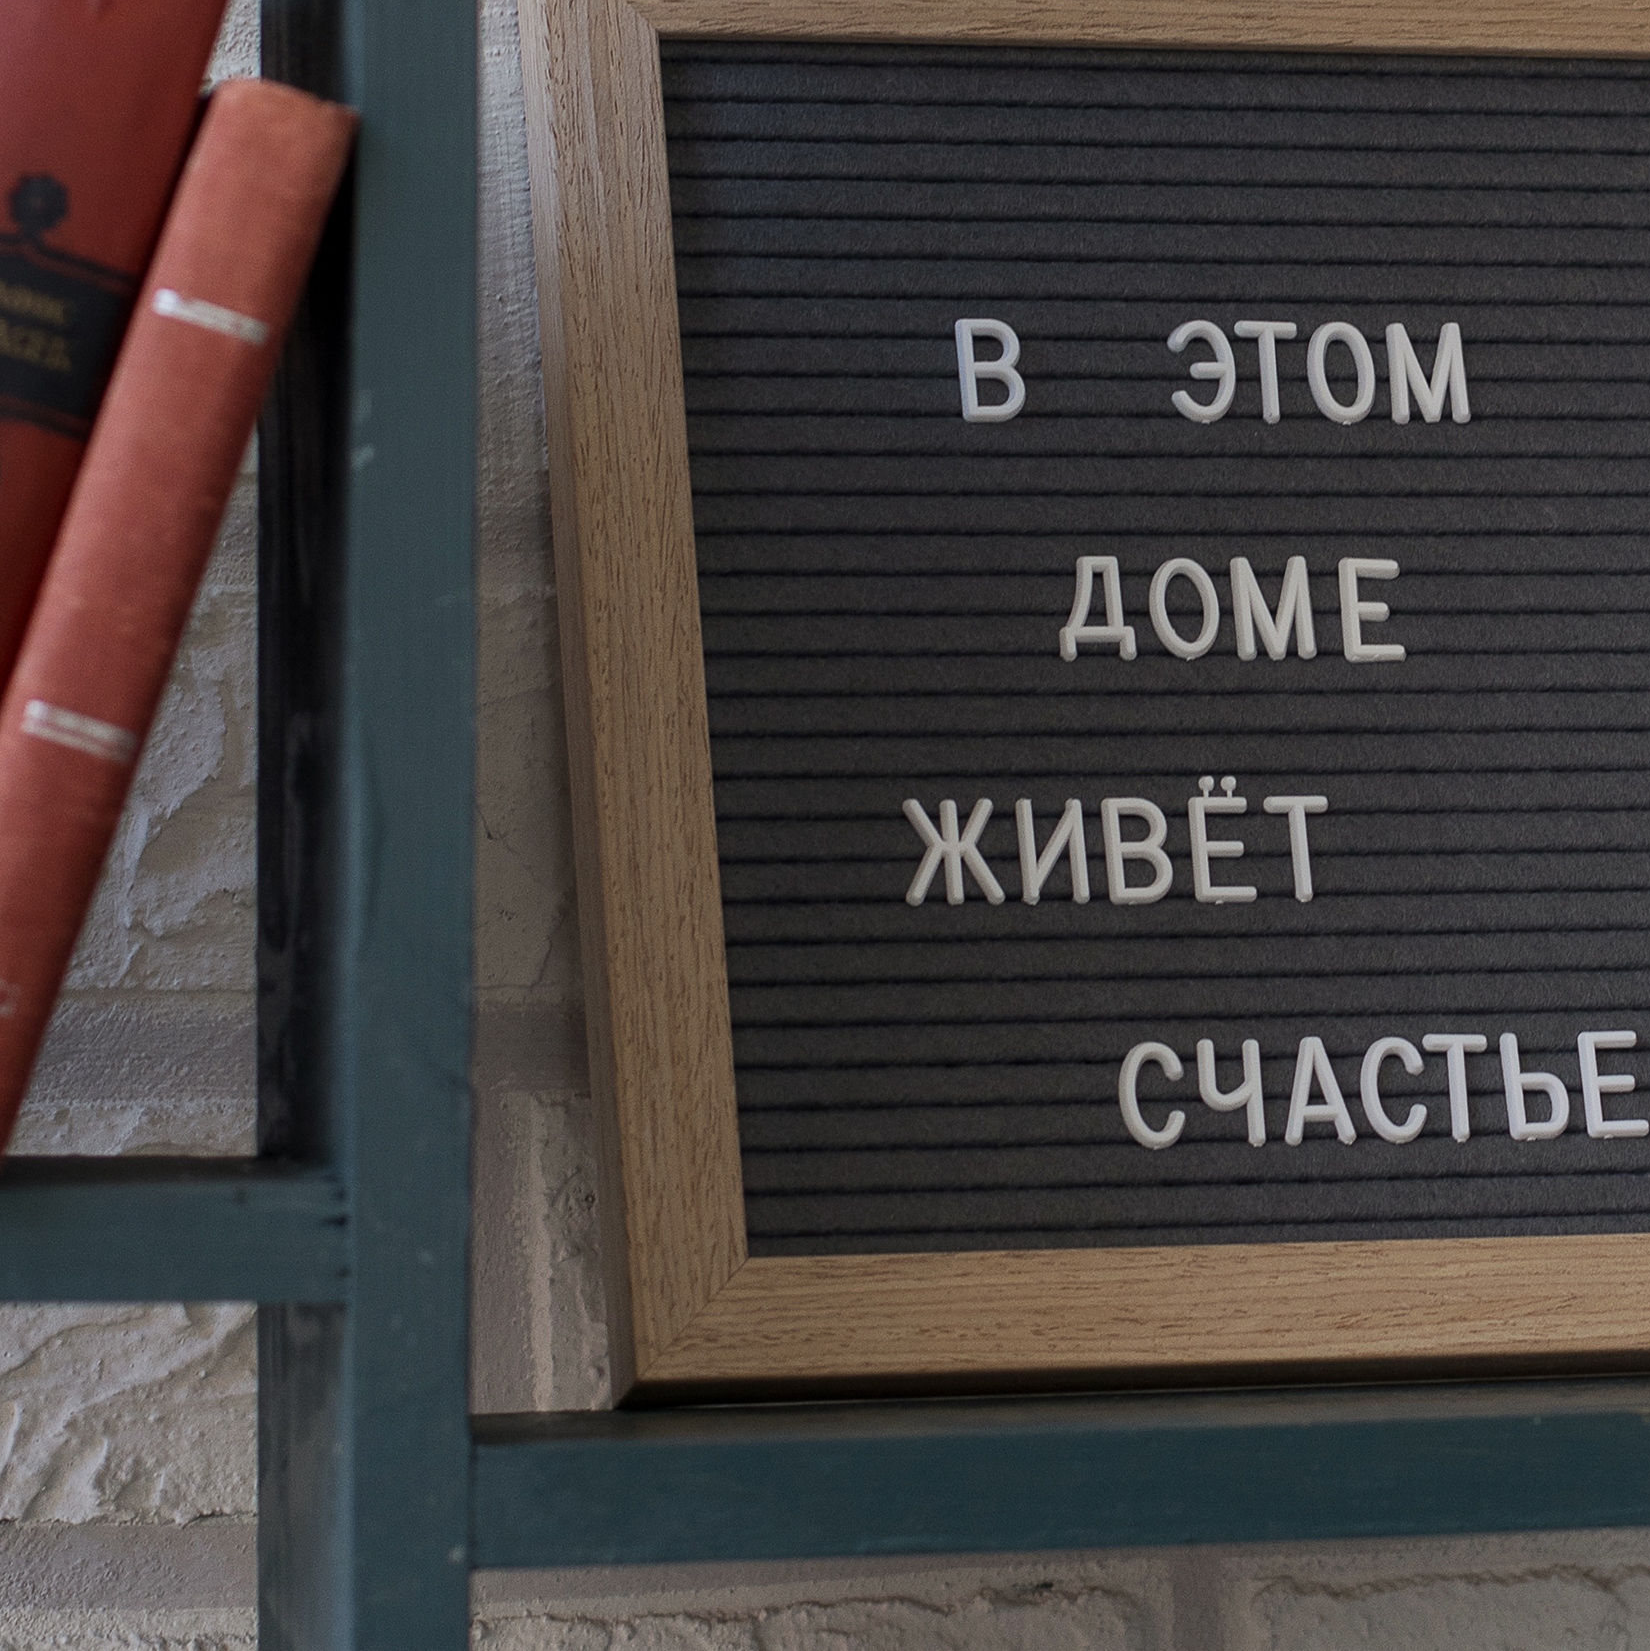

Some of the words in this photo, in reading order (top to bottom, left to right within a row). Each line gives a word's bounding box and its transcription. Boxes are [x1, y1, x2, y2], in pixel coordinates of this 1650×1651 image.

[953, 317, 1027, 424] В
[1168, 319, 1472, 425] ЭТОМ
[1059, 554, 1406, 663] ДОМЕ
[903, 776, 1328, 905] ЖИВЁТ
[1118, 1030, 1650, 1150] СЧАСТЬЕ
